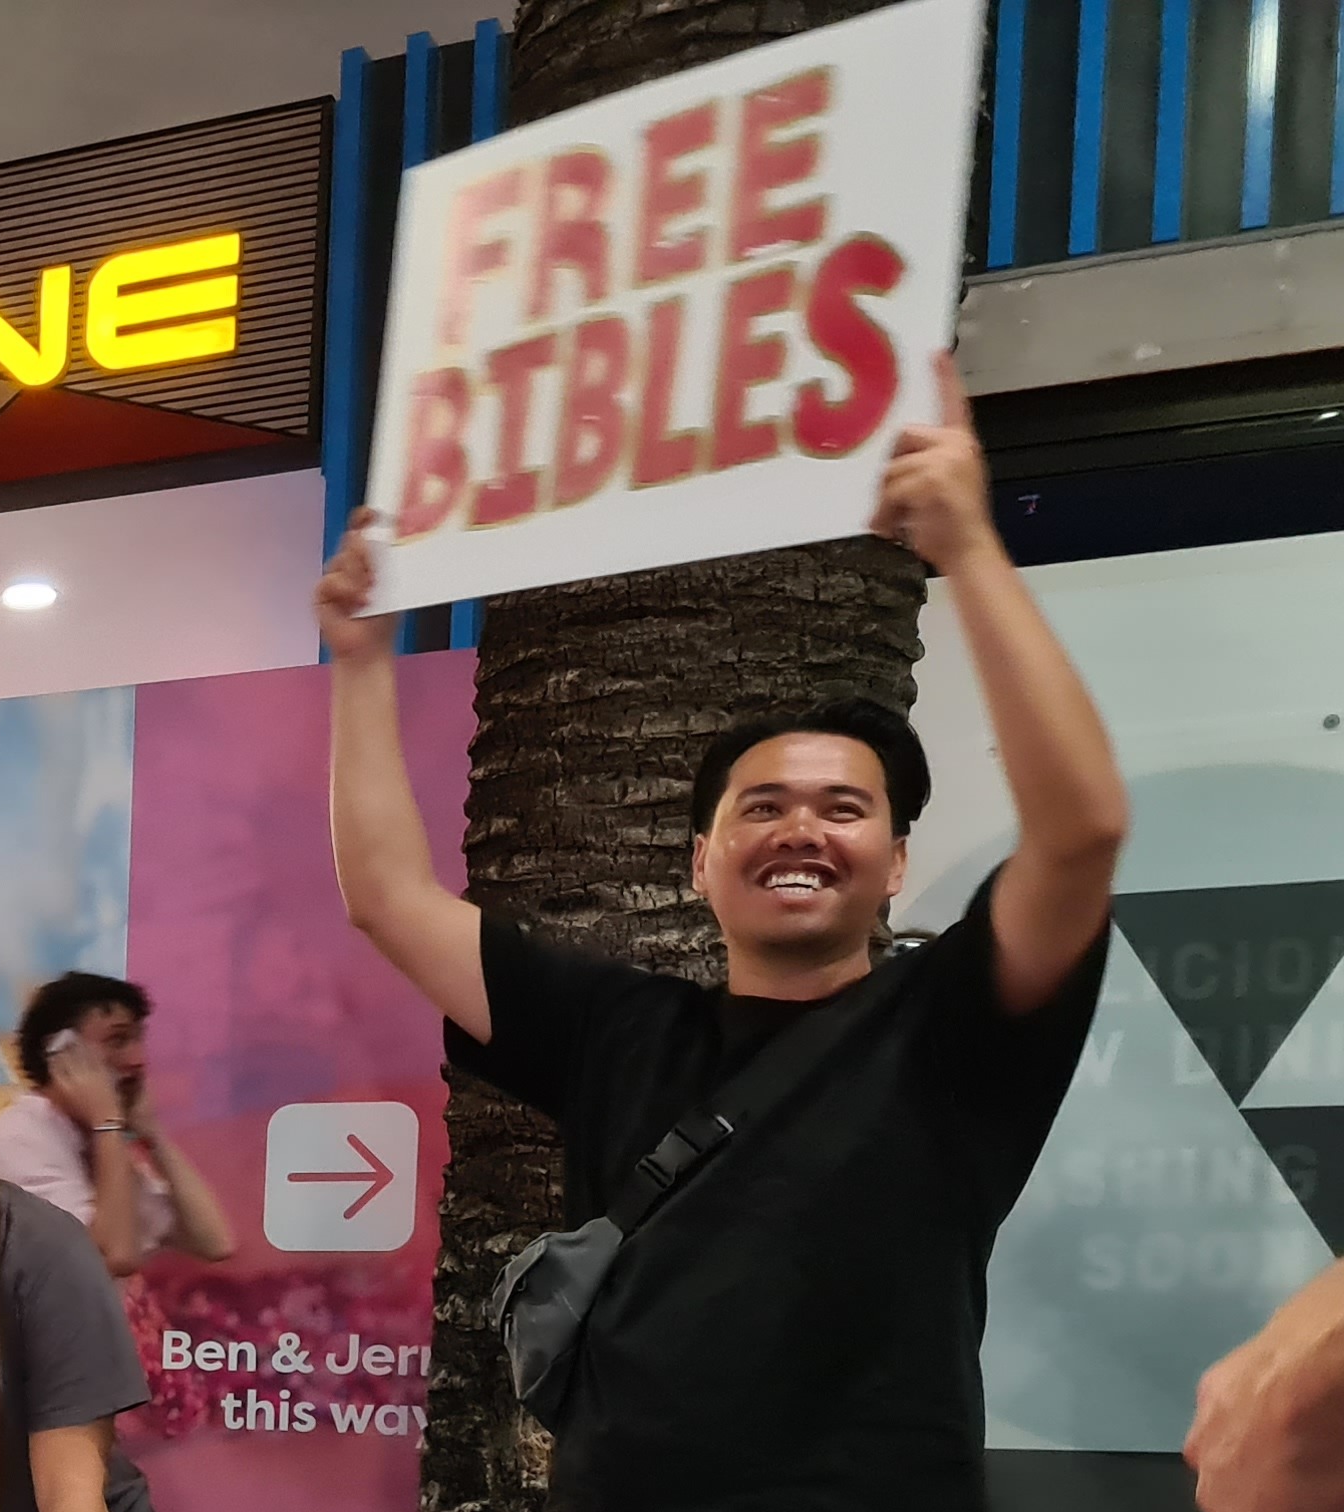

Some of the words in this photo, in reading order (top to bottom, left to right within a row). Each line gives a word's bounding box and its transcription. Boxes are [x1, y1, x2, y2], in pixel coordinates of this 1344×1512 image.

[438, 63, 840, 350] FREE
[394, 231, 908, 547] BIBLES
[161, 1330, 257, 1372] Ben
[271, 1331, 315, 1374] &
[220, 1388, 317, 1433] this
